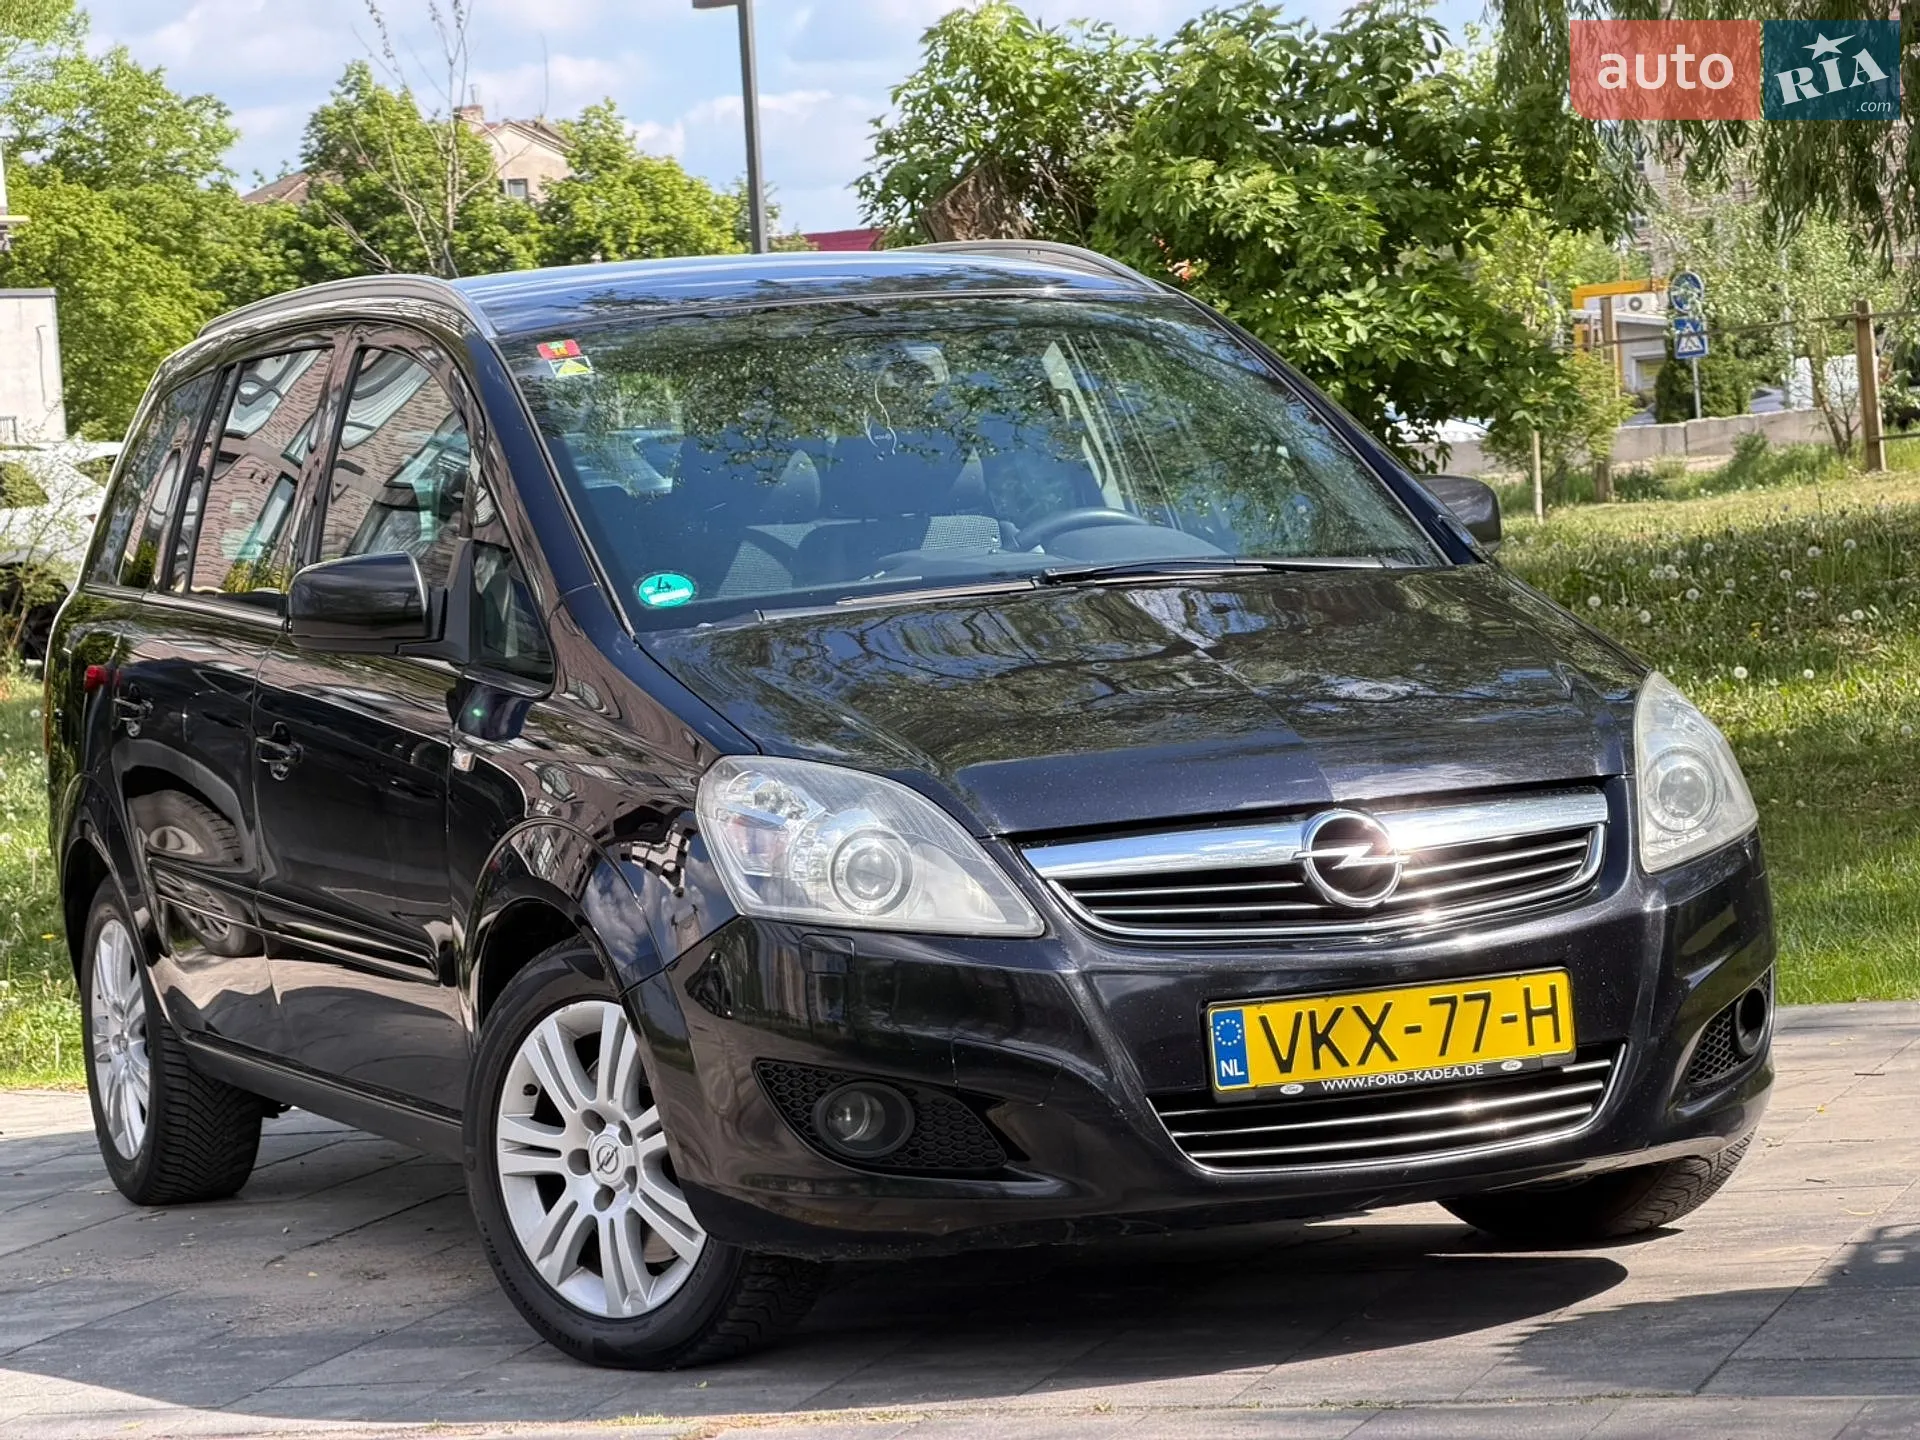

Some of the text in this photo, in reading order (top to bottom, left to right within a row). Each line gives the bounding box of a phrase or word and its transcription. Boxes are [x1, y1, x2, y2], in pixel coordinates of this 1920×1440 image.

[657, 576, 672, 589] 4
[1258, 983, 1562, 1074] VKX-77-H
[1220, 1059, 1245, 1077] NL
[1321, 1064, 1484, 1091] WWW.FORD-KADEA.DE
